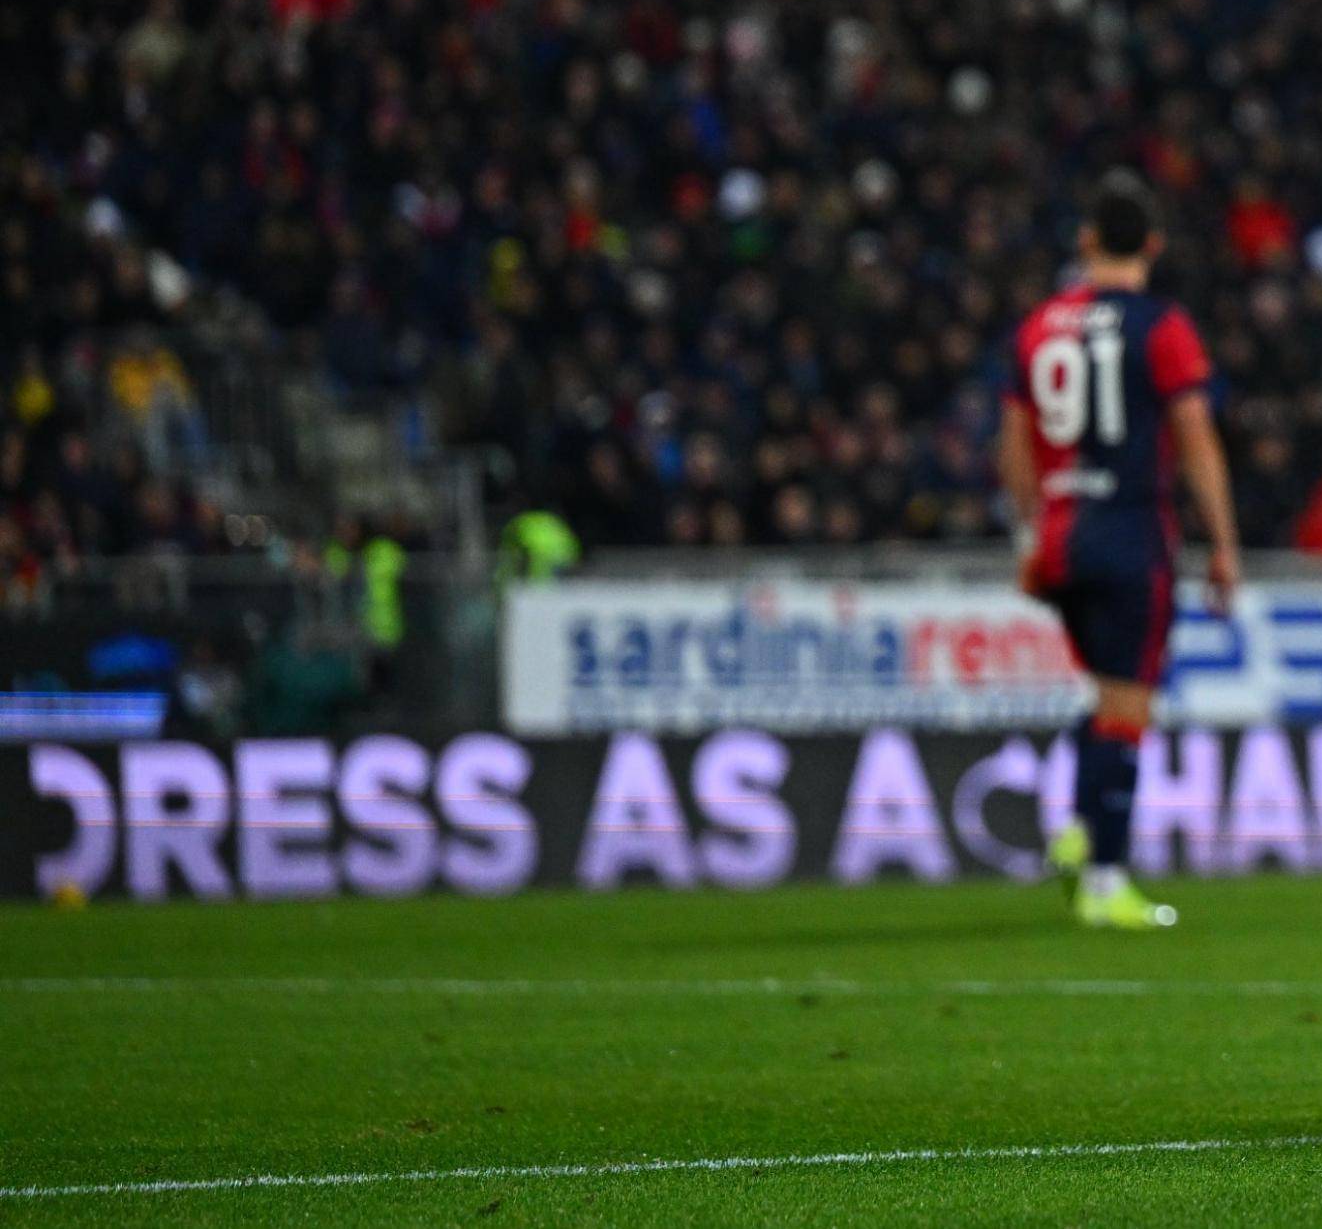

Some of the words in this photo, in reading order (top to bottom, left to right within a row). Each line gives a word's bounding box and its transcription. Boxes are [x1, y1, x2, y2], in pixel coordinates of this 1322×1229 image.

[1030, 338, 1127, 446] 91
[28, 732, 540, 902] DRESS
[577, 727, 799, 890] AS
[832, 726, 958, 885] A
